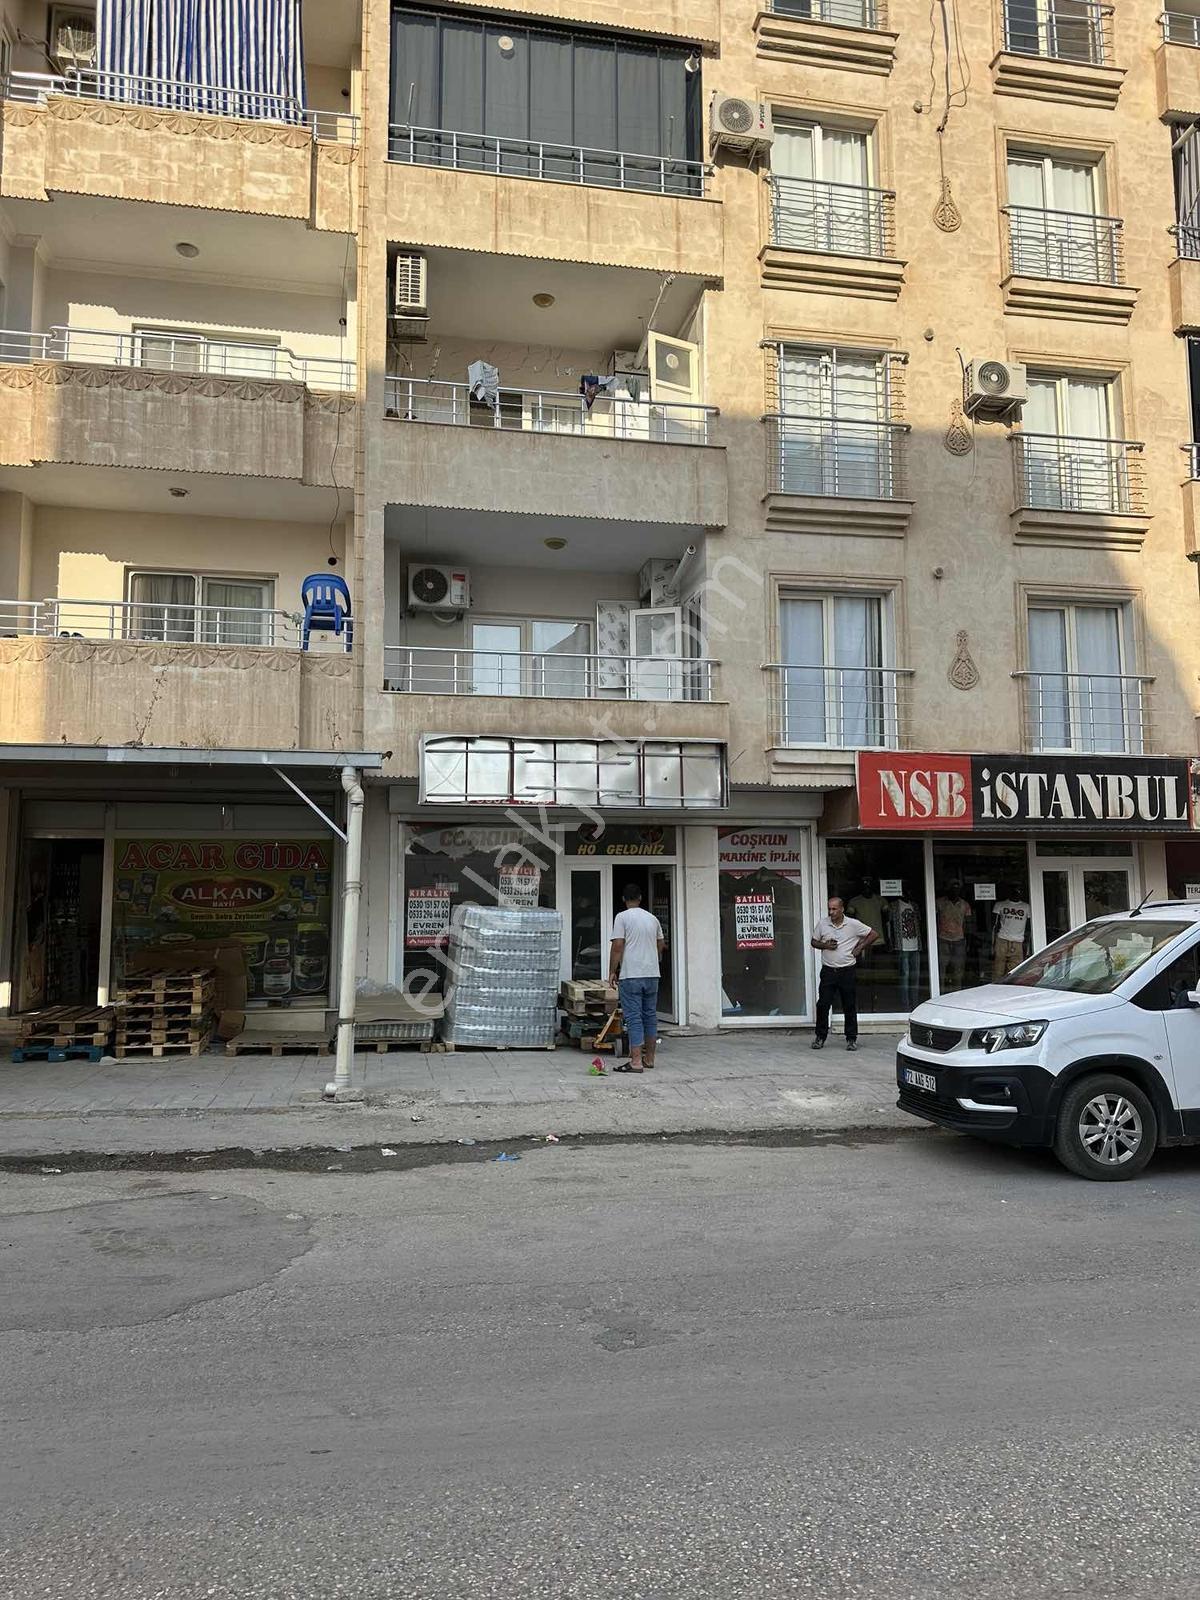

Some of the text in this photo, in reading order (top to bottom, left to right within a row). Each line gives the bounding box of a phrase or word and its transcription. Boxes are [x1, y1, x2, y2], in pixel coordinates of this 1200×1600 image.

[877, 769, 968, 817] NSB
[730, 834, 788, 849] COŞKUN
[119, 842, 329, 871] ACAR GIDA
[719, 850, 800, 862] MAKİNE İPLİK
[181, 887, 263, 900] ALKAN
[409, 889, 449, 897] KIRALIK
[736, 895, 771, 903] SATILIK
[409, 900, 423, 909] 0530
[424, 900, 433, 908] 151
[441, 900, 449, 909] 00
[409, 910, 422, 918] 0533
[423, 910, 433, 918] 296
[441, 910, 449, 918] 60
[737, 905, 772, 914] 0530 151 57 00
[737, 915, 749, 923] 0533
